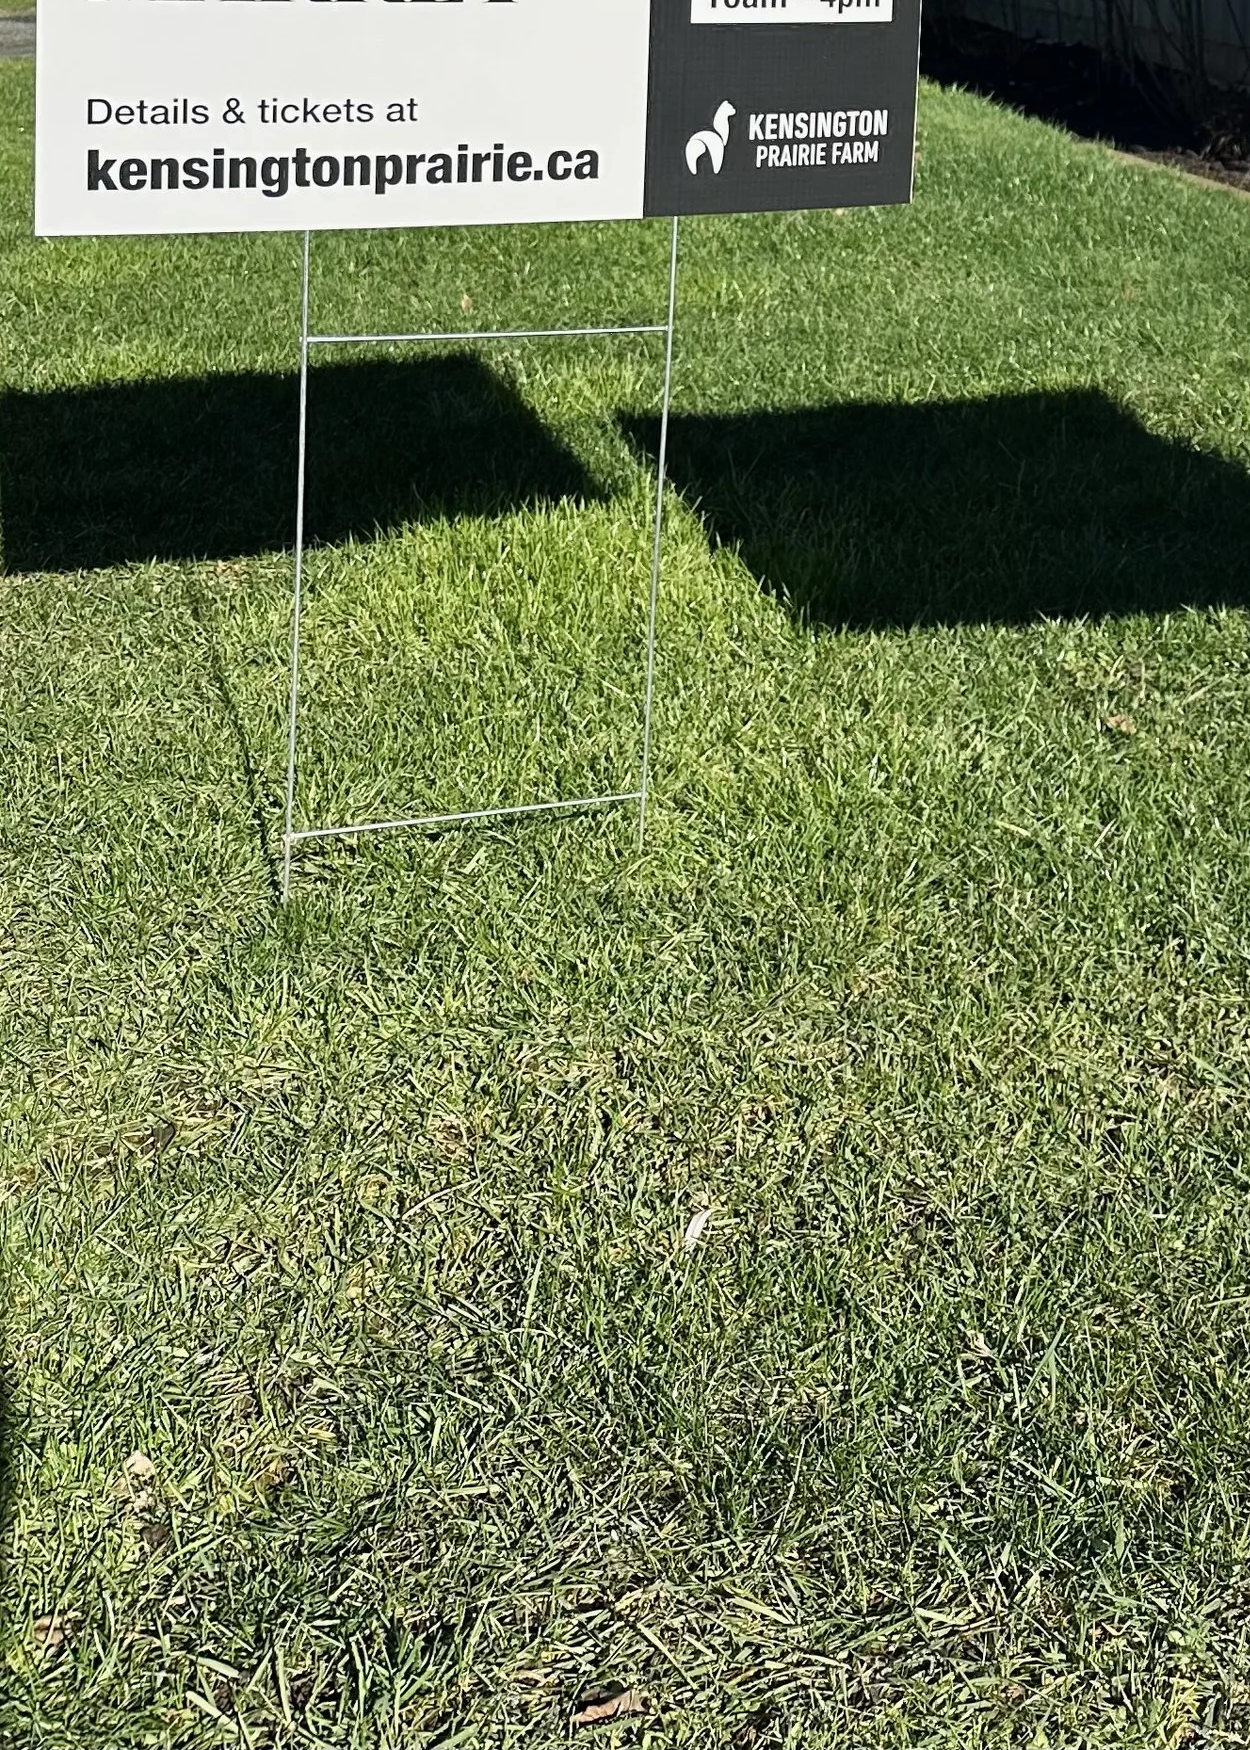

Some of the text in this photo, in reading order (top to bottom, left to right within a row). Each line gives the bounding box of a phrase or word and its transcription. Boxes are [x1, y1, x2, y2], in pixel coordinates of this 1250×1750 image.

[87, 97, 418, 126] Details & tickets at
[749, 110, 889, 141] KENSINGTON
[755, 140, 880, 168] PRAIRIE FARM
[87, 143, 599, 198] kensingtonprairie.ca
